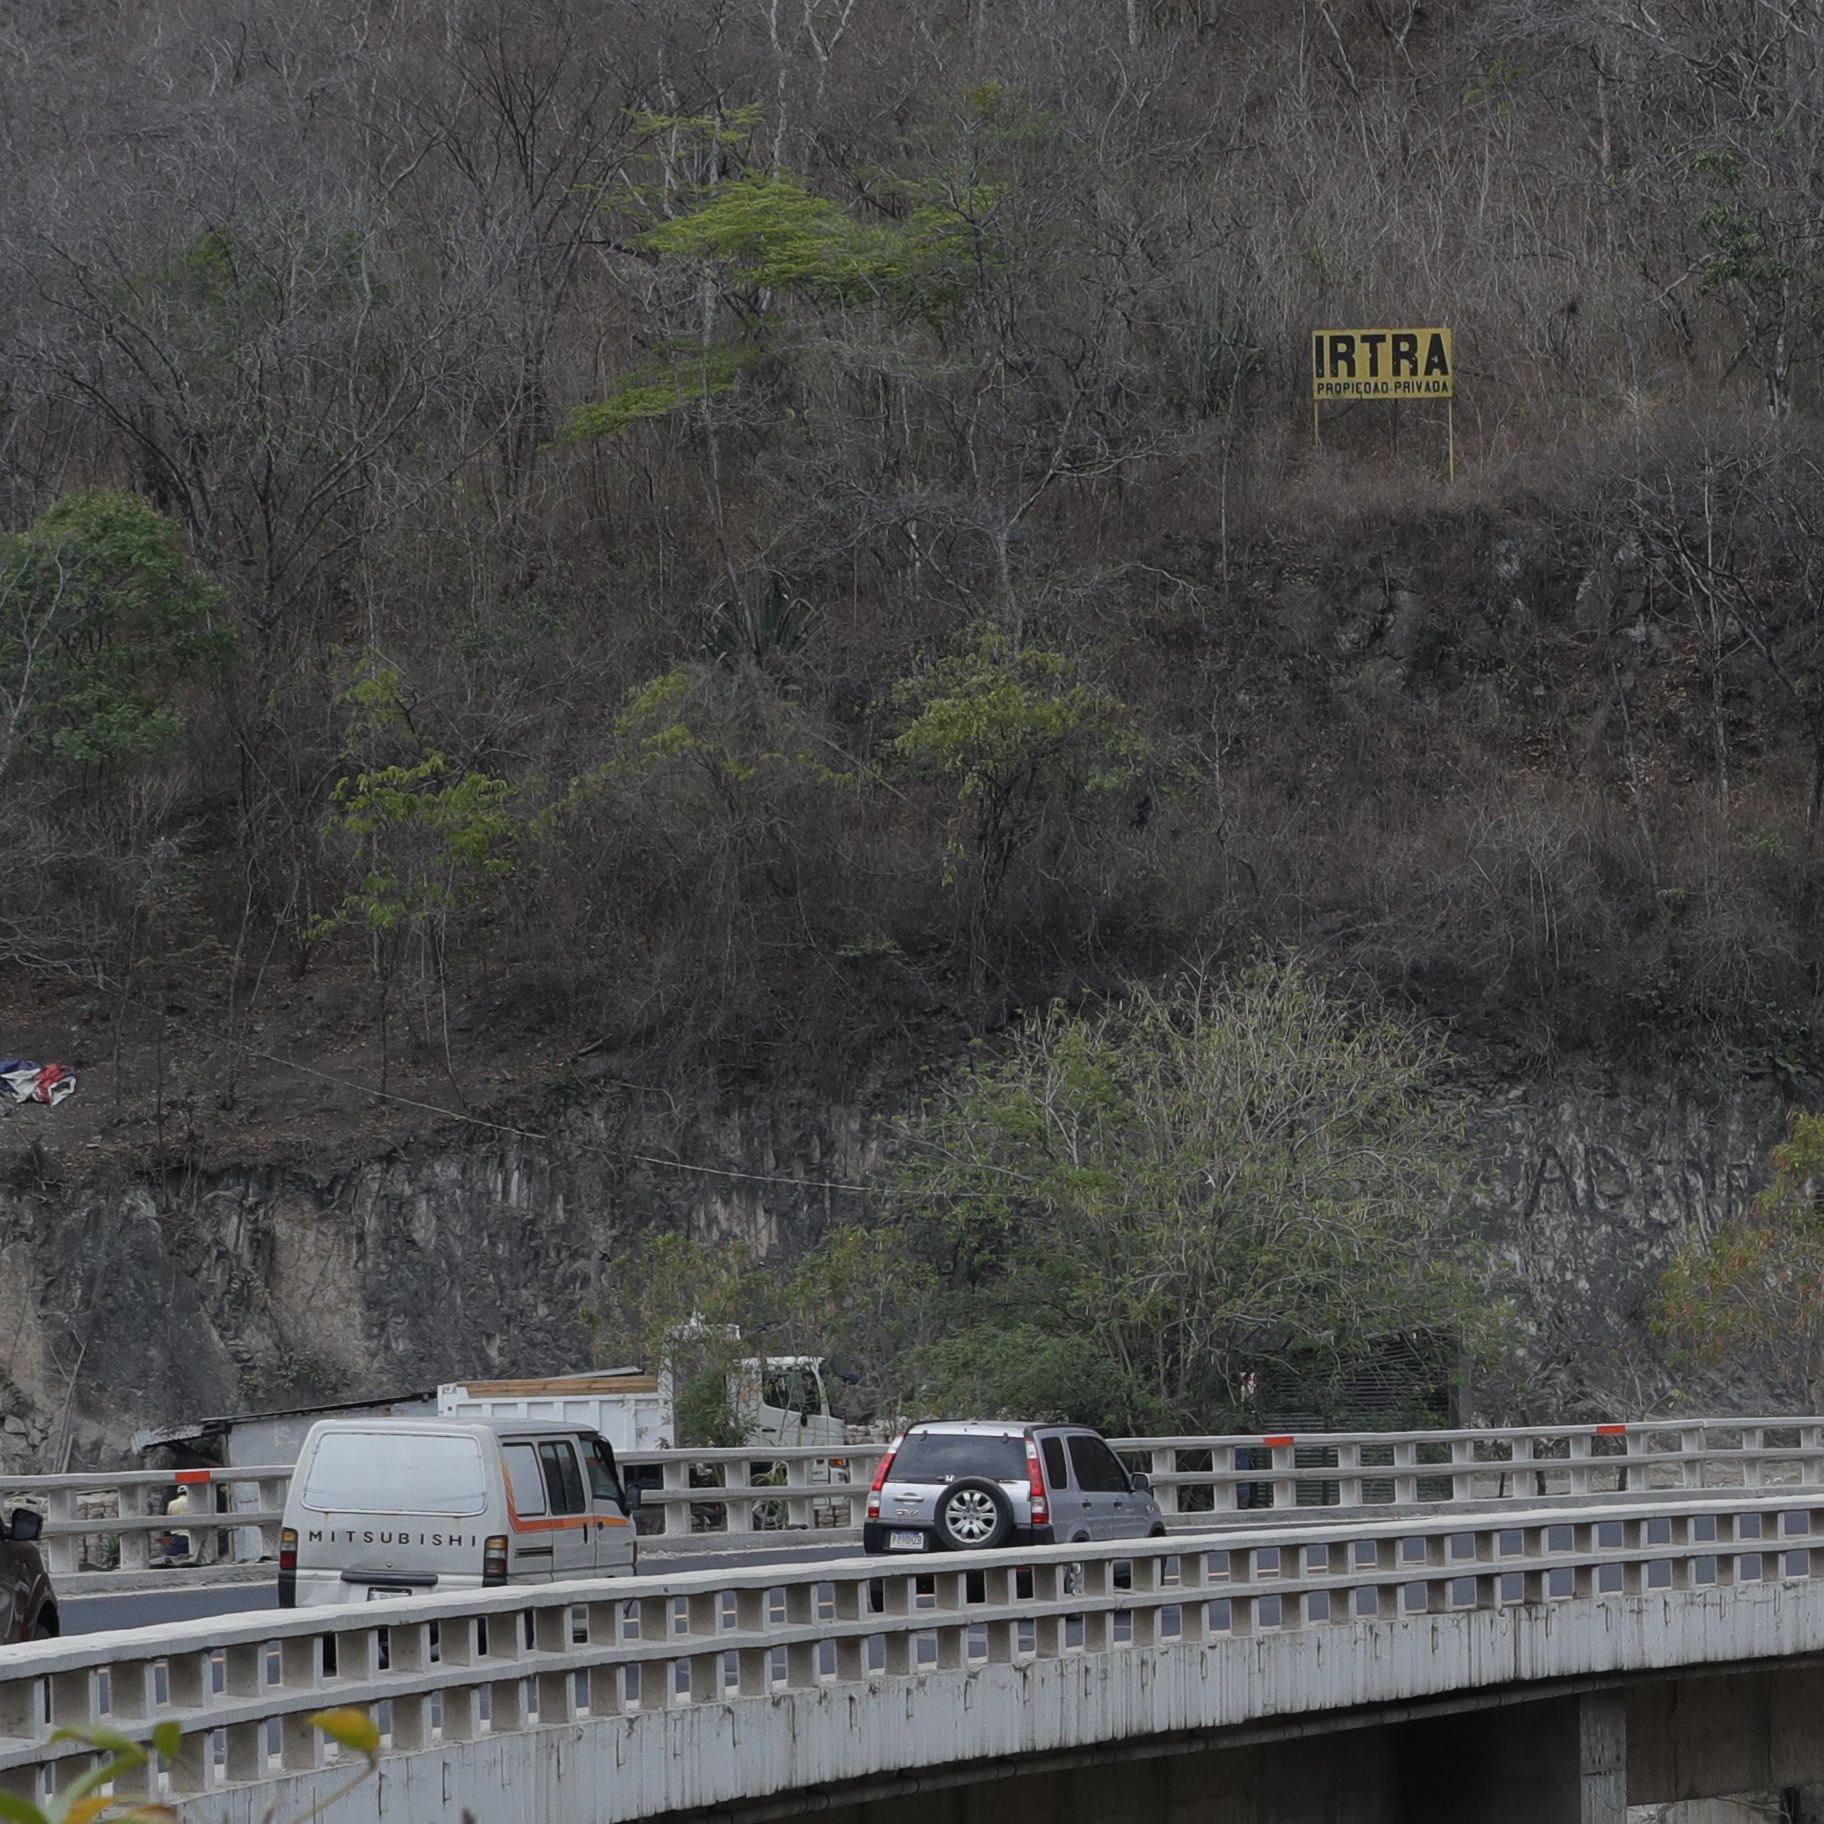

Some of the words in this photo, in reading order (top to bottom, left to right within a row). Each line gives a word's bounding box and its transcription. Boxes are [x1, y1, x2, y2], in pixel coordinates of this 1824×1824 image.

[1315, 333, 1450, 378] IRTRA
[1317, 381, 1389, 395] PROPIEDAD
[1394, 380, 1448, 394] PRIVADA
[309, 1530, 477, 1547] MITSUBISHI
